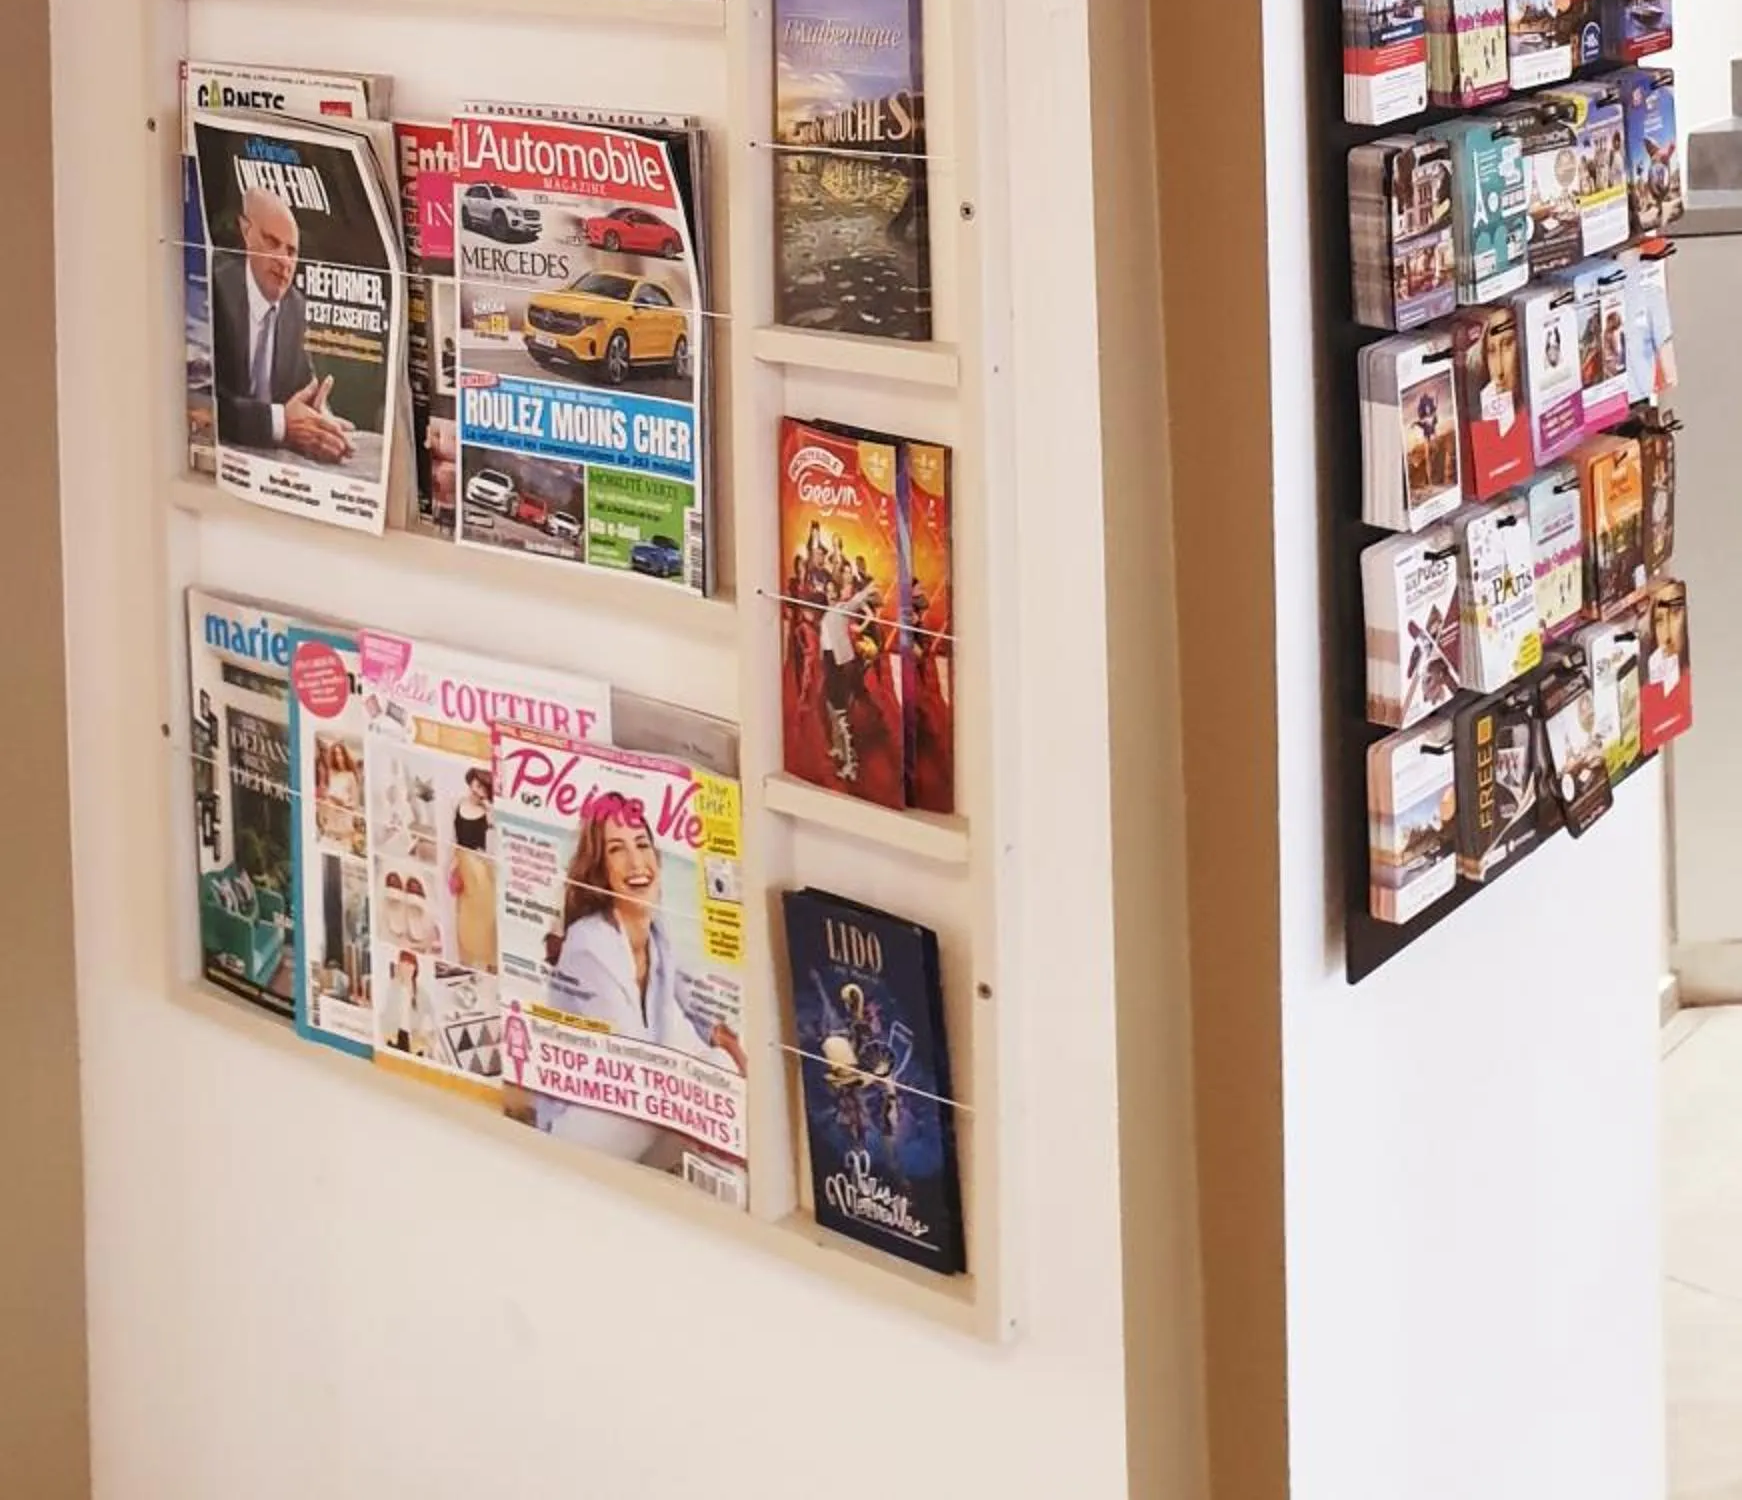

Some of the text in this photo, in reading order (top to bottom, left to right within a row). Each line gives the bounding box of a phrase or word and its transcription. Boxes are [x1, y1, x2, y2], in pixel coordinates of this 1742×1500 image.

[461, 121, 666, 192] L'Automobile
[543, 177, 608, 197] MAGAZINE
[461, 244, 570, 280] MERCEDES
[464, 387, 545, 438] ROULEZ
[550, 401, 628, 450] MOINS
[633, 413, 691, 464] CHER
[205, 612, 289, 668] marie
[440, 680, 597, 740] COUTURE
[504, 748, 707, 850] Pleine Vie
[1477, 742, 1495, 830] FREE
[825, 917, 884, 975] LIDO
[537, 1066, 641, 1112] VRAIMENT
[539, 1042, 590, 1074] STOP
[595, 1056, 637, 1084] AUX
[641, 1066, 737, 1121] TROUBLES
